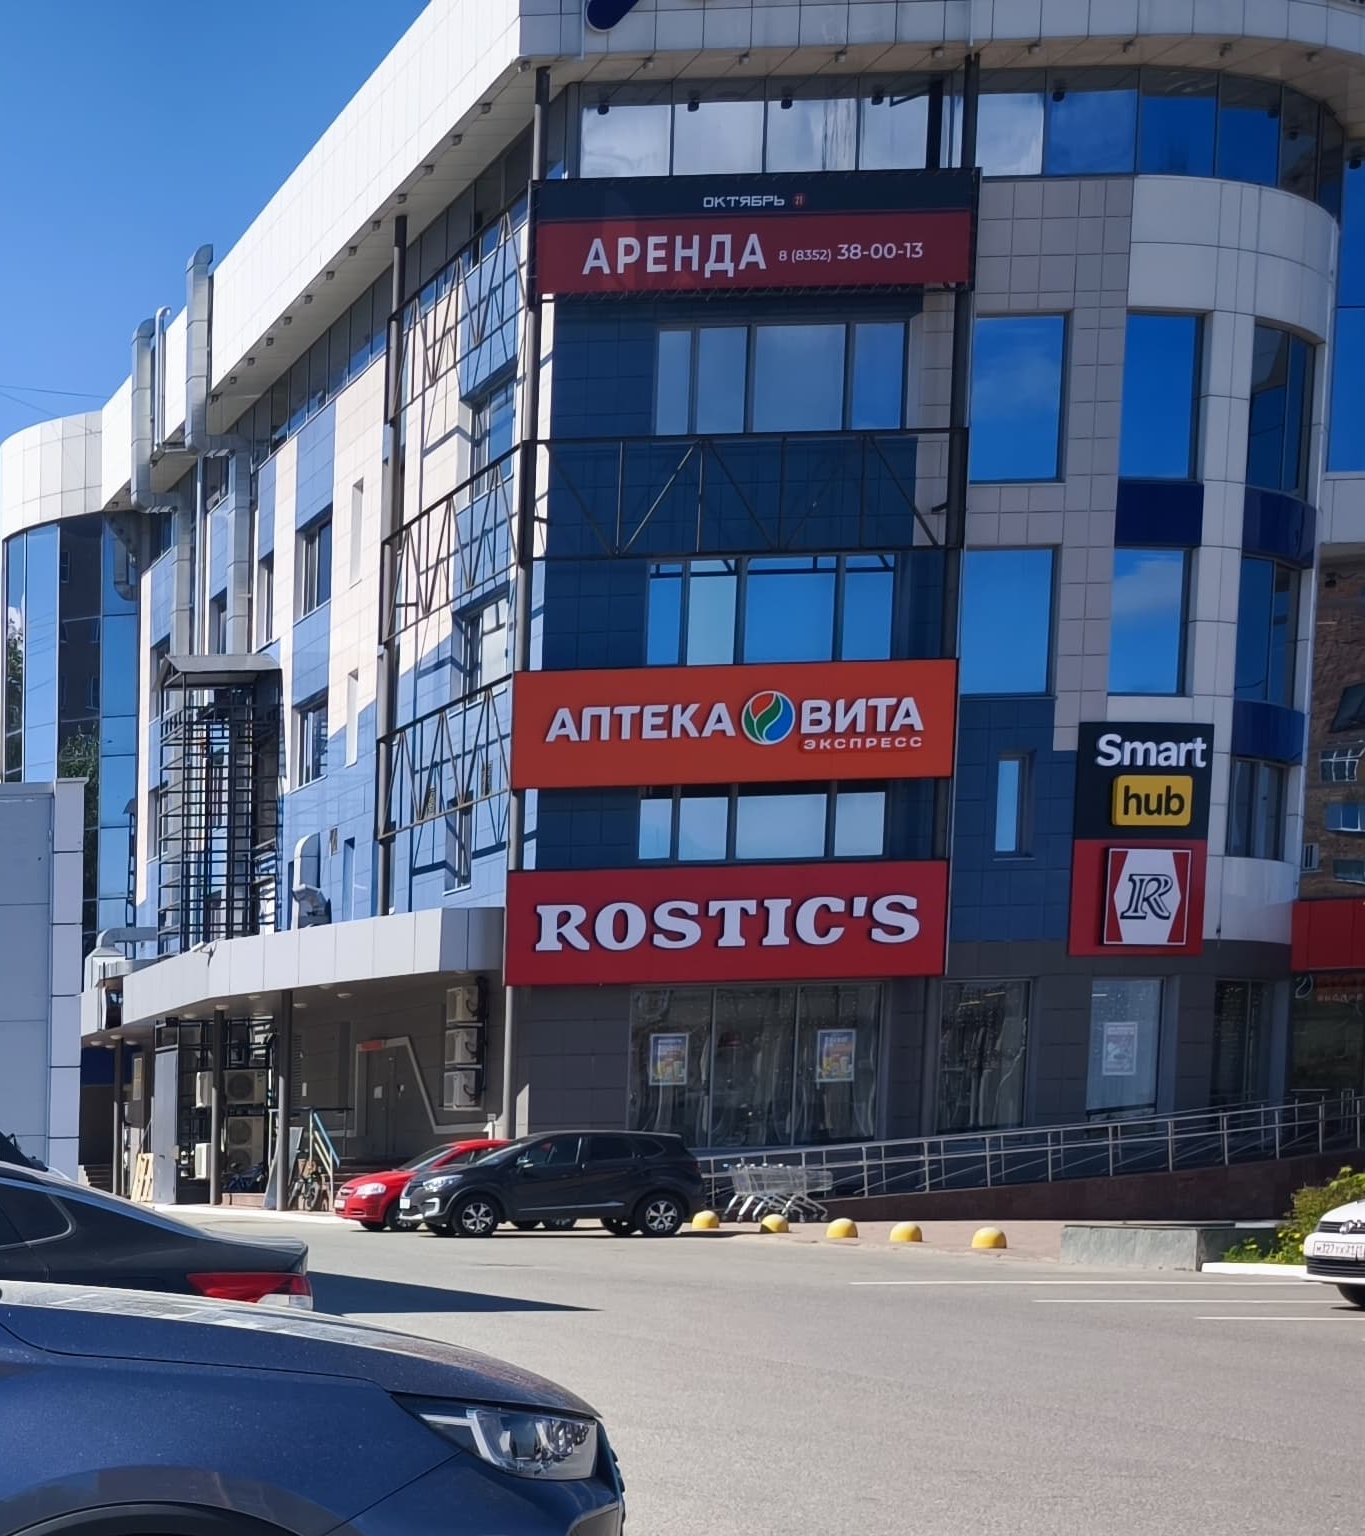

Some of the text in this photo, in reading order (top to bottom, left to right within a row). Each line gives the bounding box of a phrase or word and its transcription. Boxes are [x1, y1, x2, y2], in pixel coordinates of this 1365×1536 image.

[703, 195, 785, 208] ОКТЯБРЬ
[582, 233, 924, 279] АРЕНДА 8 (8352) 38-00-13
[545, 696, 925, 743] АПТЕКА ВИТА
[803, 736, 923, 750] ЭКСПРЕСС
[1096, 733, 1207, 768] Smart
[1123, 785, 1185, 816] hub
[1120, 873, 1174, 921] R
[535, 894, 921, 952] ROSTIC'S
